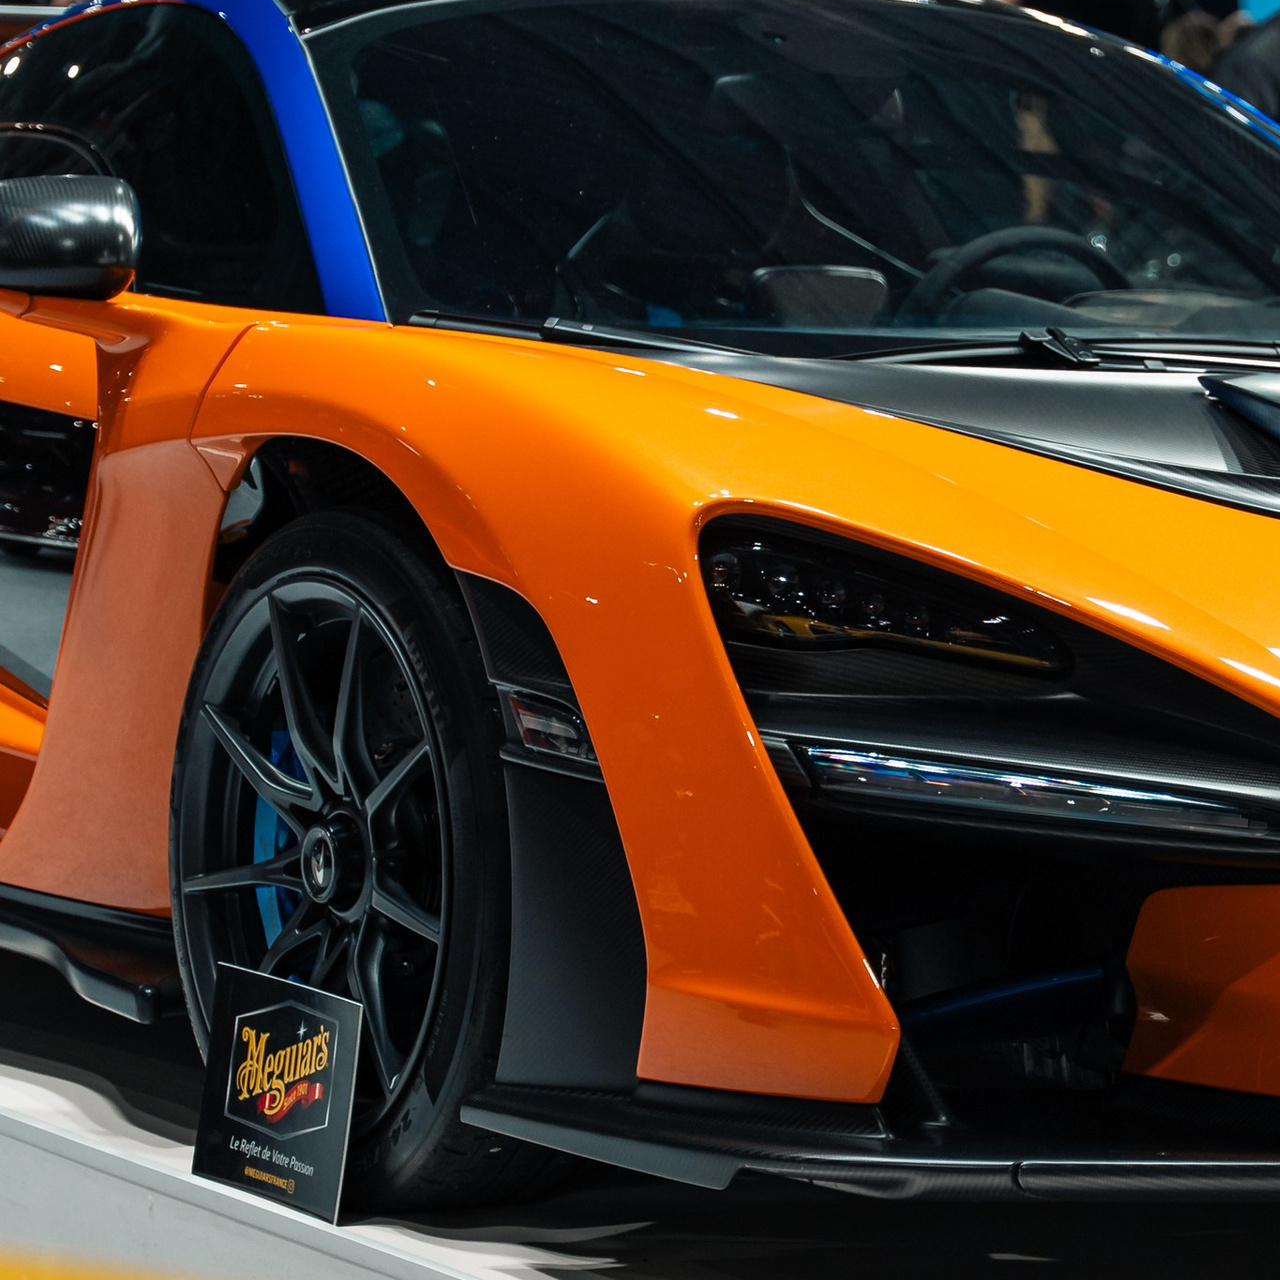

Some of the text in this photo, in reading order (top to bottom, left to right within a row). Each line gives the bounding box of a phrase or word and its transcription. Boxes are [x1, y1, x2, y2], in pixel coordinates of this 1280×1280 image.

[236, 1024, 330, 1116] Meguiar's
[297, 1082, 309, 1096] 1901
[229, 1135, 315, 1177] Le Reflet de Votre Passion
[244, 1166, 288, 1190] @MEGUIARSFRANCE
